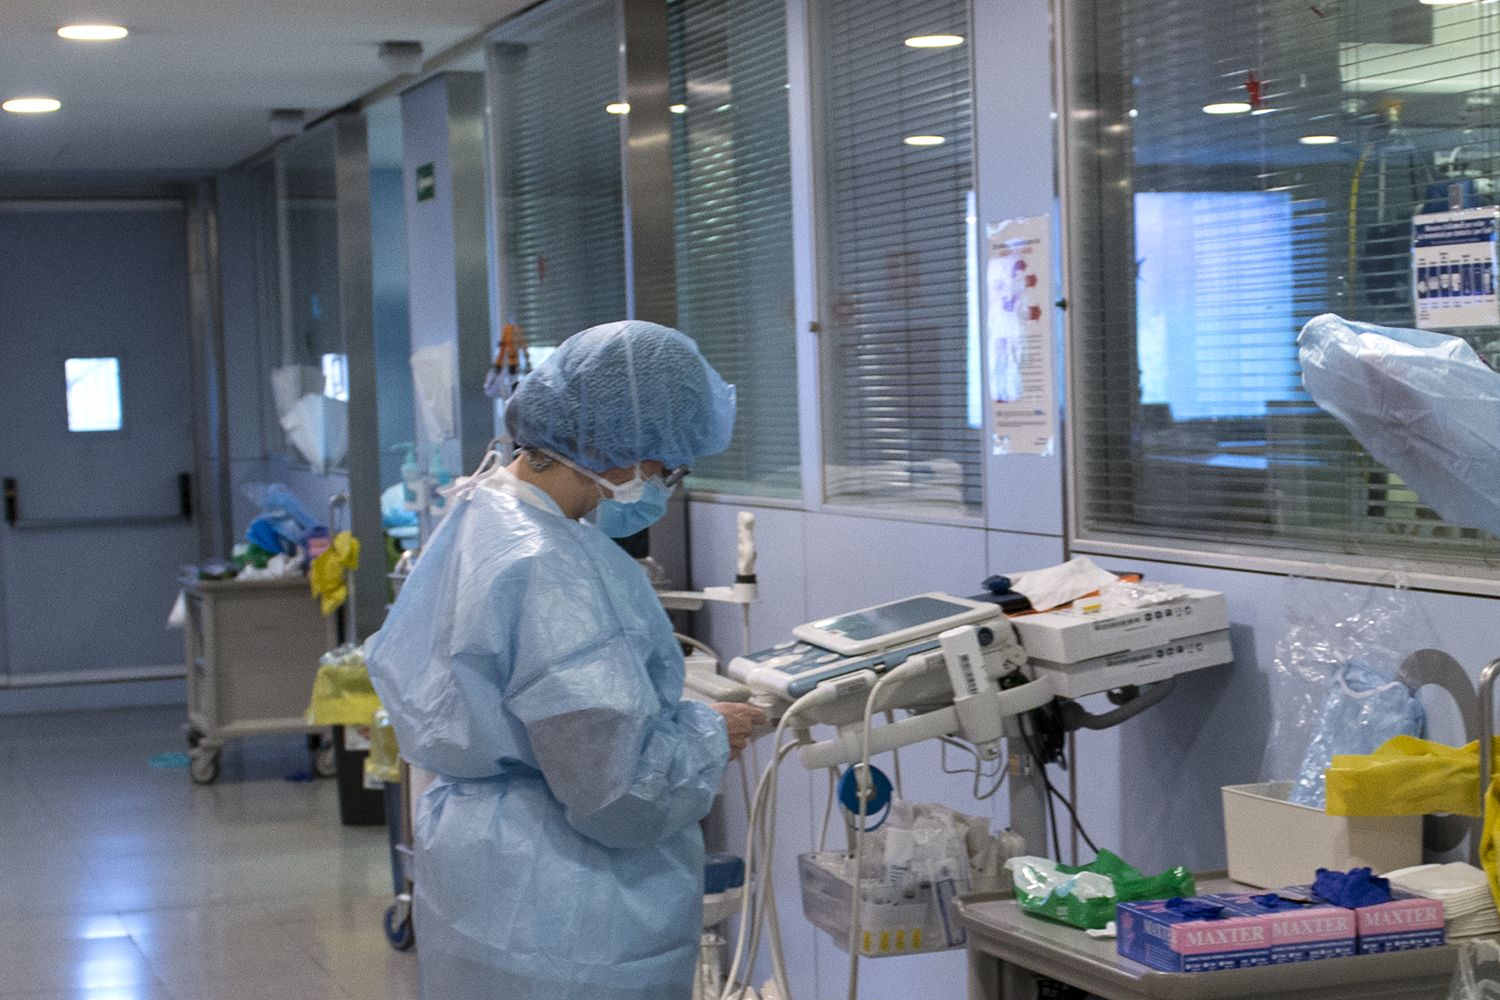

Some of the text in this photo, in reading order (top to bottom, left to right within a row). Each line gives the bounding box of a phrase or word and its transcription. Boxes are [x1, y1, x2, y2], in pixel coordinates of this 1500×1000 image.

[1271, 917, 1349, 938] MAXTER
[1363, 906, 1438, 928] MAXTER
[1185, 926, 1265, 946] MAXTER
